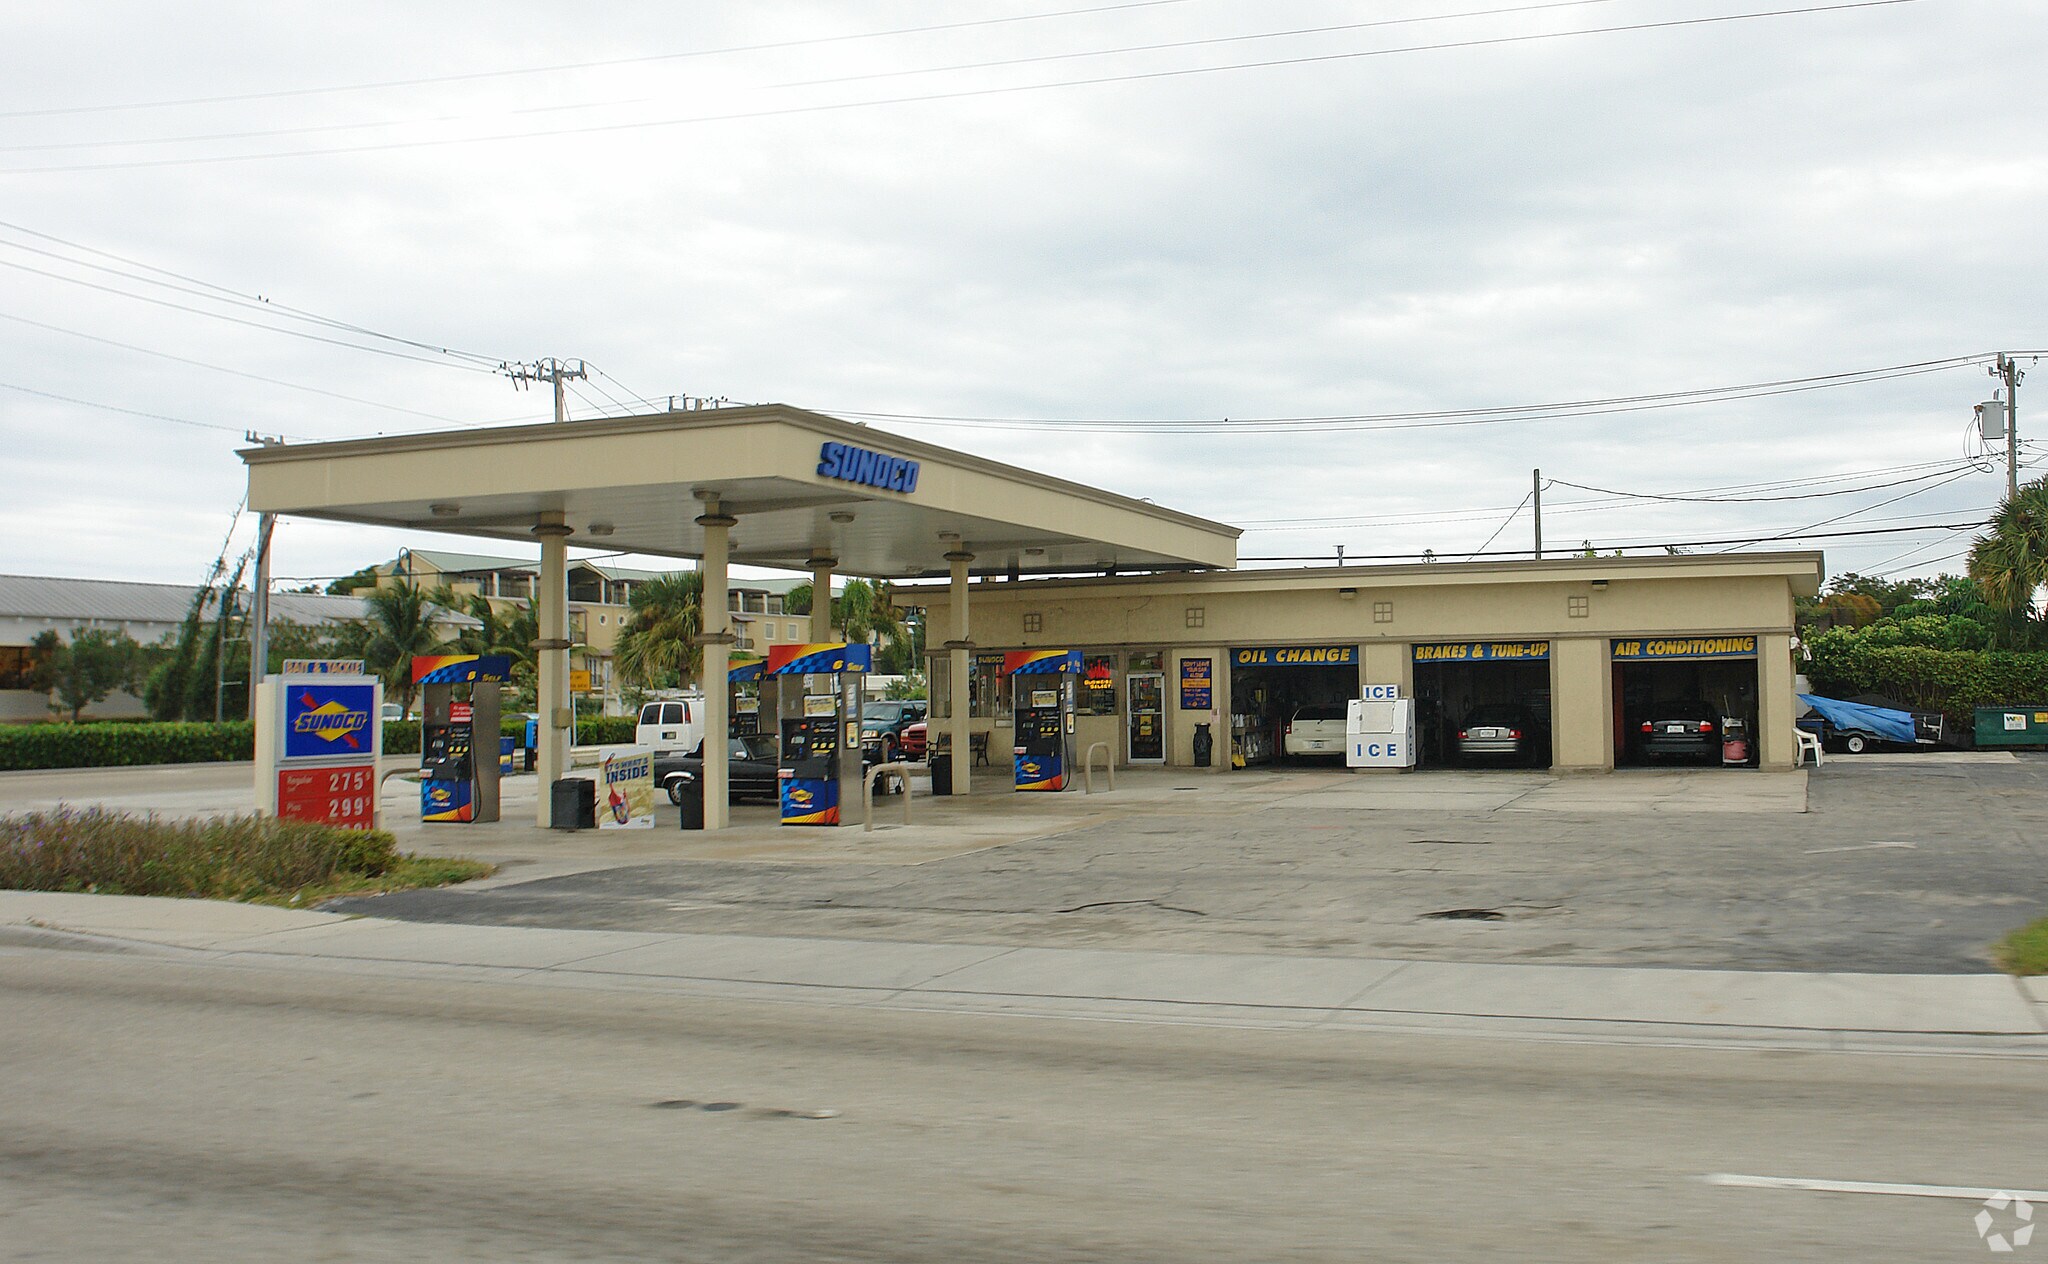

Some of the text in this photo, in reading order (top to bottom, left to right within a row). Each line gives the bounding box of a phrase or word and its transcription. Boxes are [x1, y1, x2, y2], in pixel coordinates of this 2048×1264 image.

[817, 442, 919, 493] SUNOCO
[1416, 643, 1548, 660] BRAKES & TUNE-UP
[1615, 637, 1754, 655] AIR CONDITIONING
[1238, 649, 1351, 663] OIL CHANGE
[1365, 687, 1395, 699] ICE
[296, 712, 366, 732] SUNOCO
[1357, 744, 1397, 757] ICE
[606, 765, 648, 784] INSIDE
